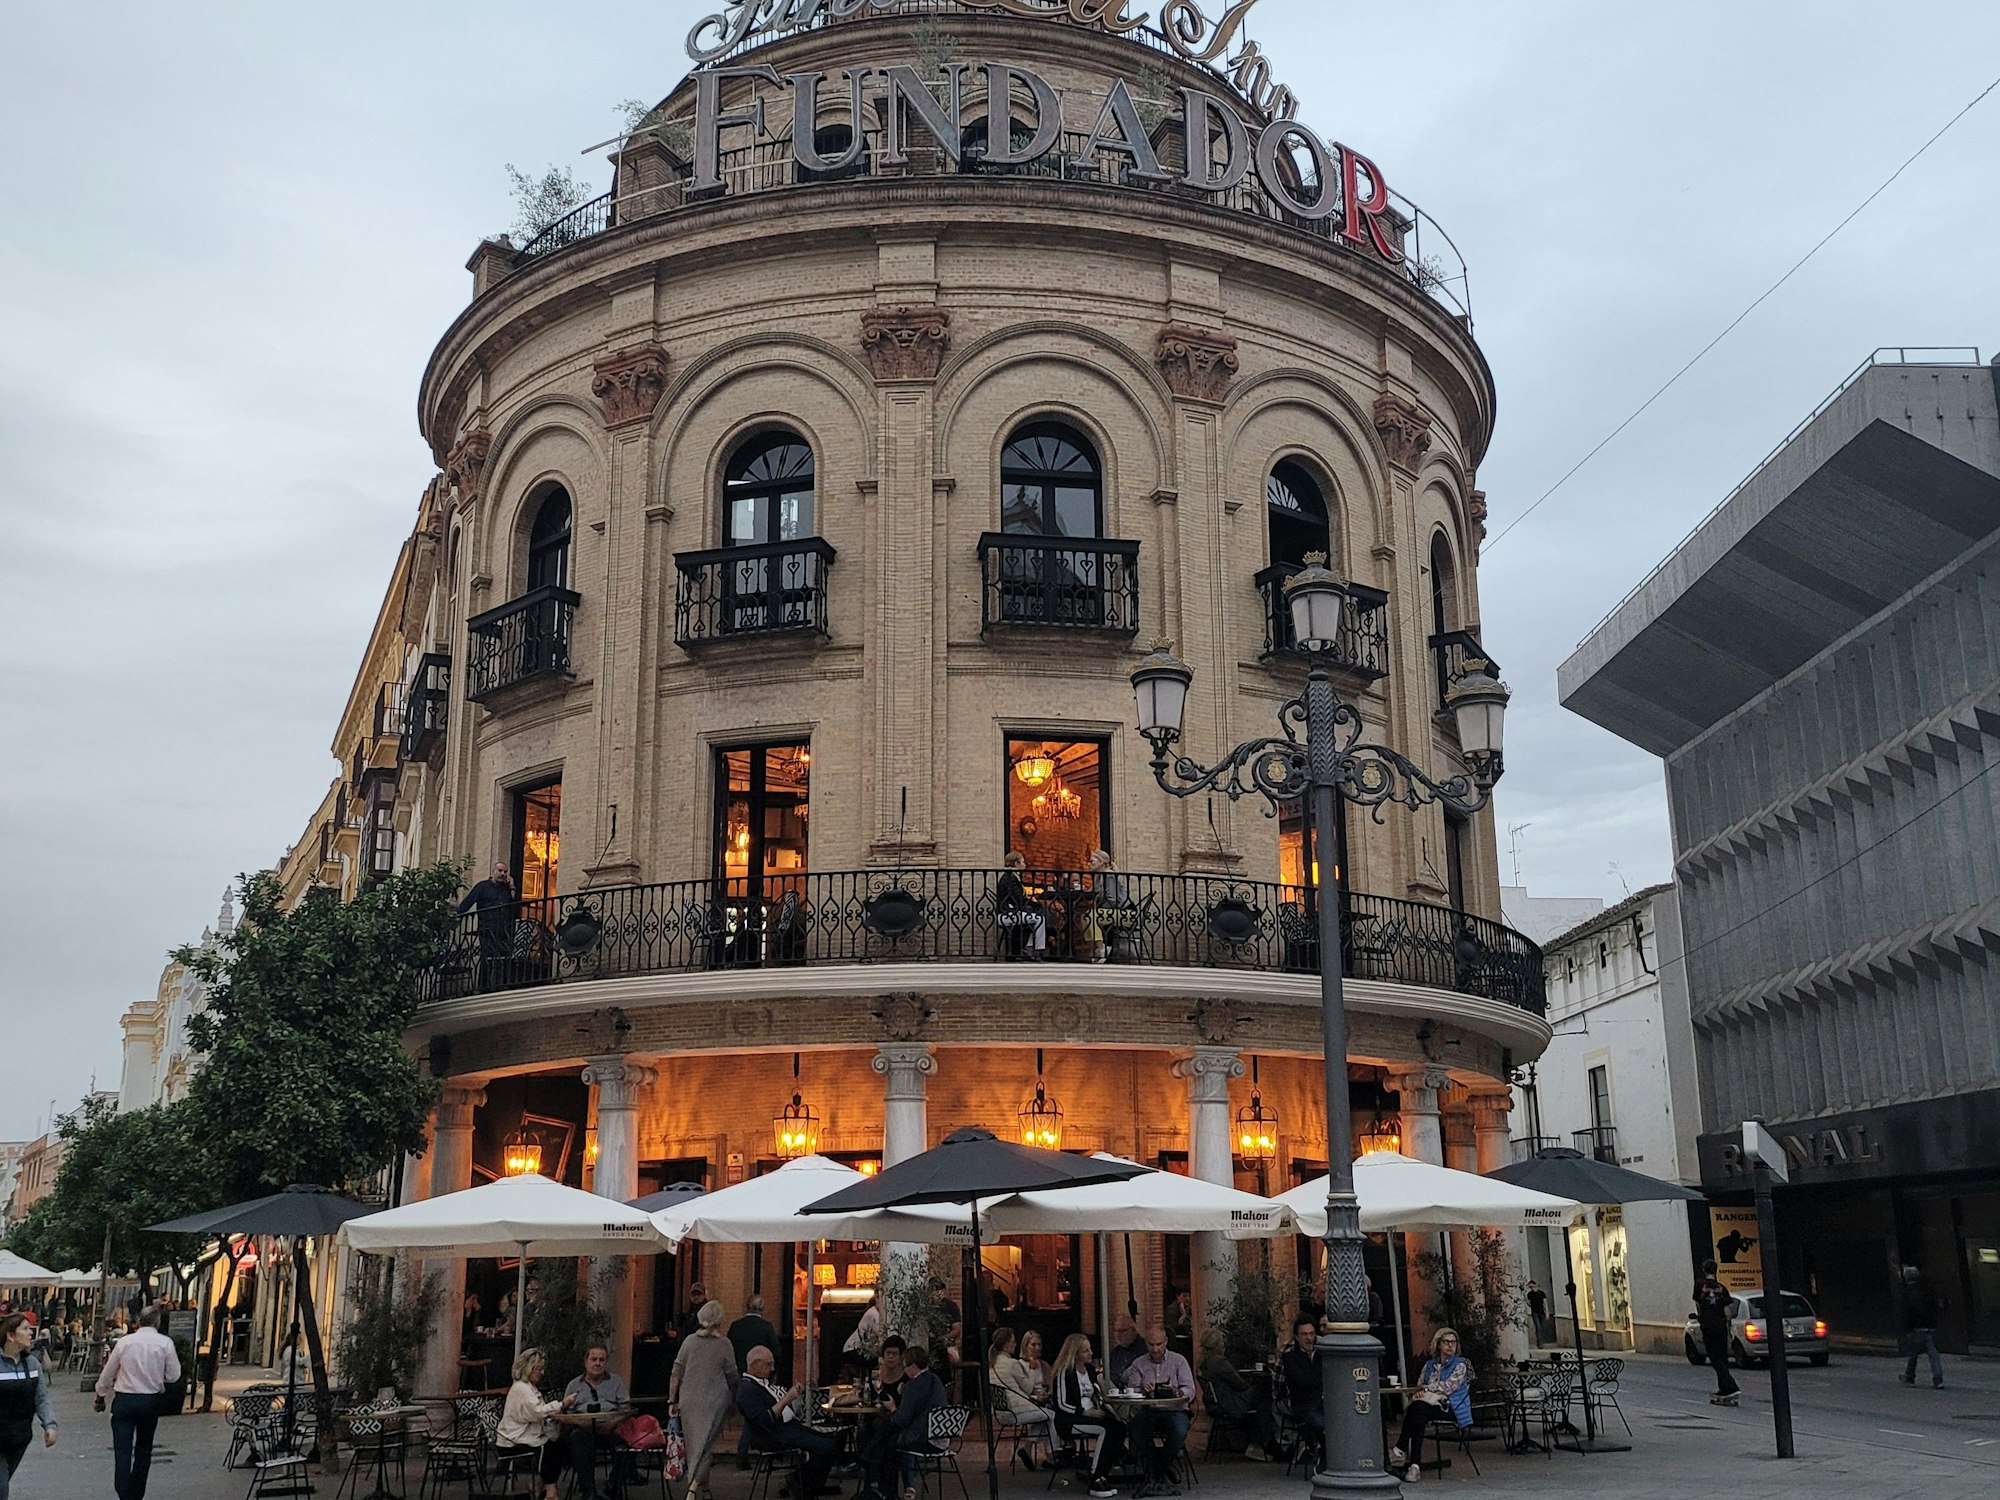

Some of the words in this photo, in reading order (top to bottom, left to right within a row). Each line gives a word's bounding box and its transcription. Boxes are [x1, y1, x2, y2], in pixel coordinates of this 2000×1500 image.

[684, 62, 1406, 264] FUNDADOR
[1231, 1210, 1269, 1221] Mahou
[1524, 1208, 1561, 1218] Mahou
[1715, 1213, 1758, 1221] RANGER
[603, 1223, 644, 1232] Mahou
